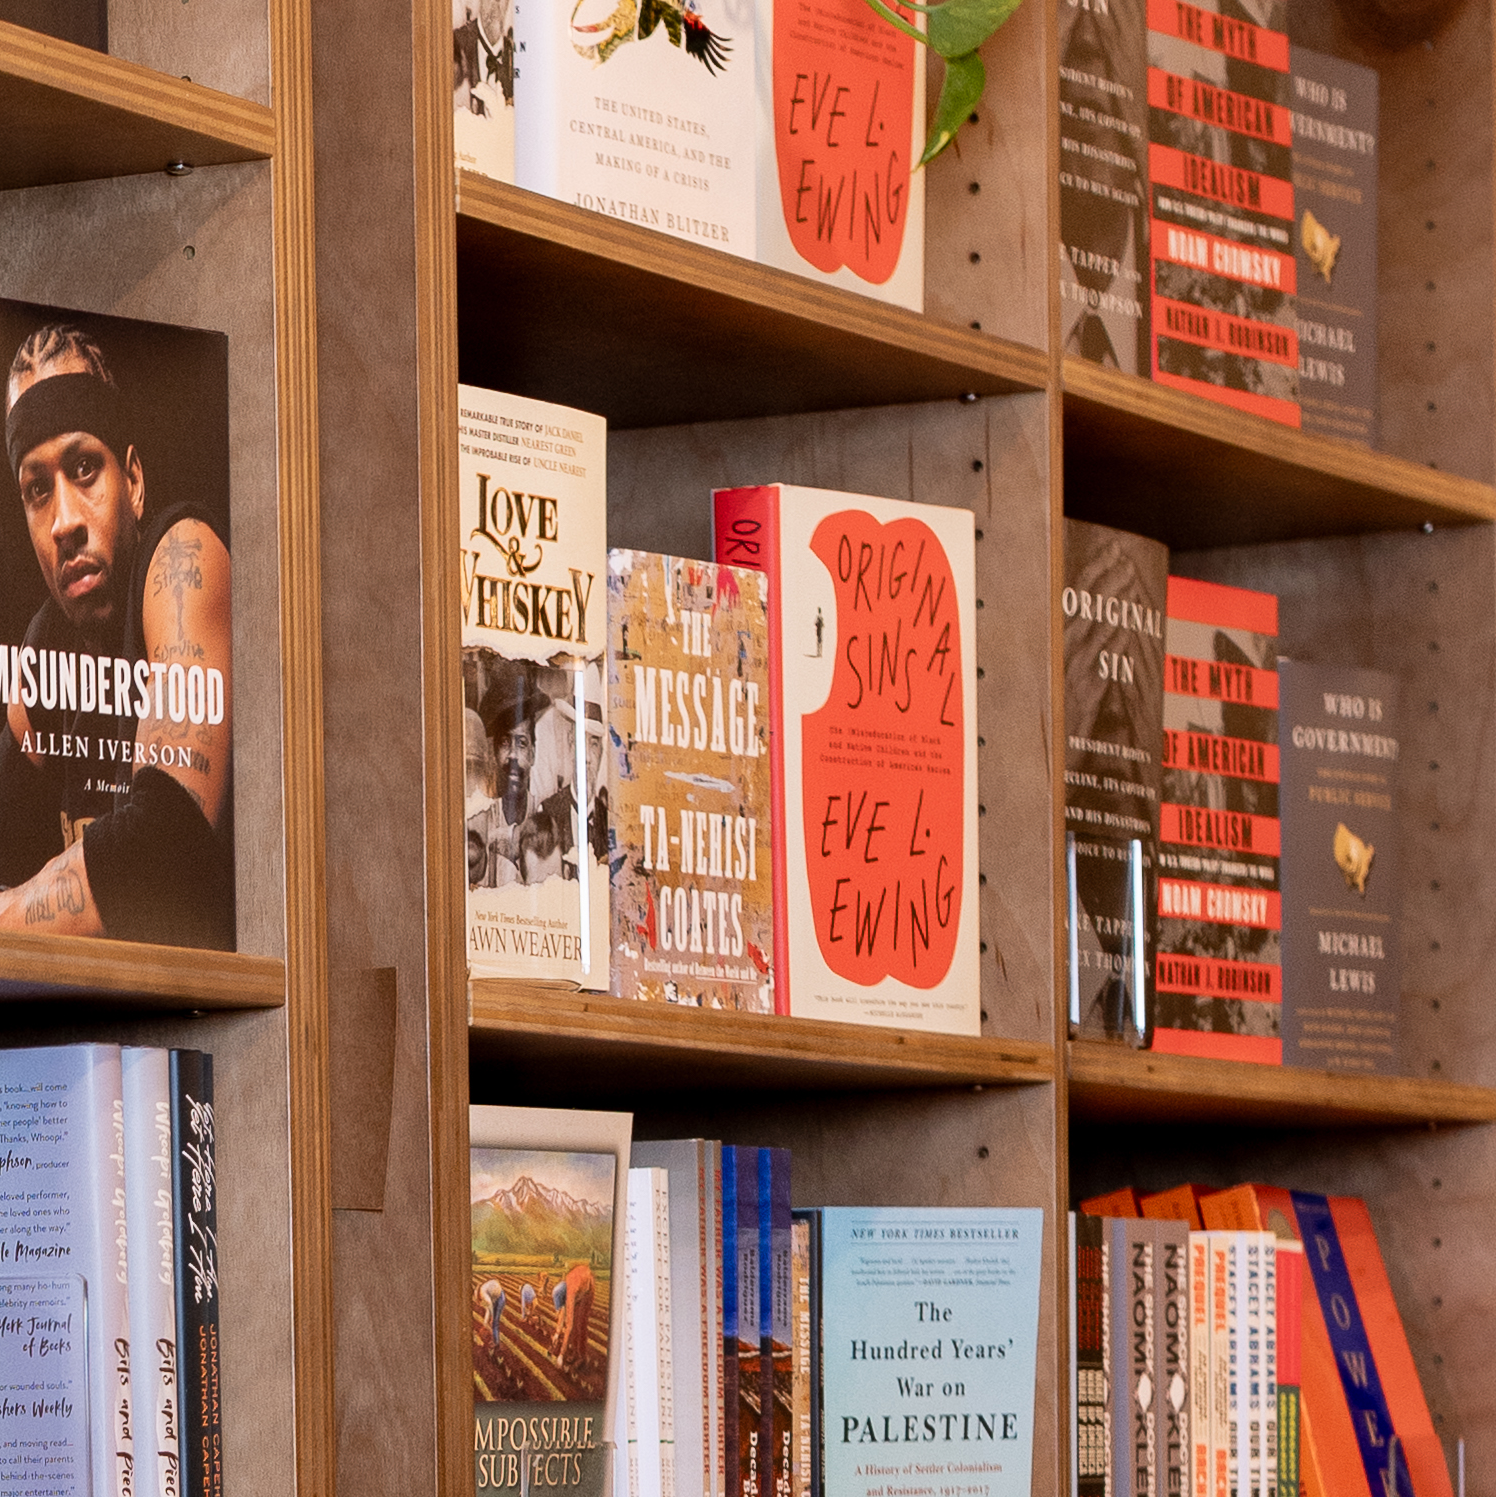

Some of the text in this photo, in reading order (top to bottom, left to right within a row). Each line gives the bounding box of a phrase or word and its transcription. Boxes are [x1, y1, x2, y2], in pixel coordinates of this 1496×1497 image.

[1176, 2, 1258, 63] THE MYTH
[594, 96, 710, 138] THE UNITED STATES,
[1182, 152, 1262, 208] IDEALISM
[470, 472, 559, 543] LOVE
[680, 610, 712, 658] THE
[837, 532, 958, 729] ORIGINAL
[1062, 585, 1164, 640] ORIGINAL
[845, 618, 917, 714] SINS
[1098, 649, 1136, 686] SIN
[632, 665, 761, 759] MESSAGE
[639, 805, 759, 881] TA-NEHISI
[657, 884, 746, 959] COATES
[829, 855, 956, 969] EWING
[1160, 882, 1269, 926] NOAM CHOMSKY
[15, 1240, 71, 1262] Magazine
[914, 1301, 953, 1323] The
[1132, 1241, 1146, 1377] NAOMI
[197, 1326, 208, 1427] JONATHAN
[851, 1339, 943, 1361] Hundred
[896, 1376, 966, 1398] War on
[841, 1413, 1018, 1444] PALESTINE
